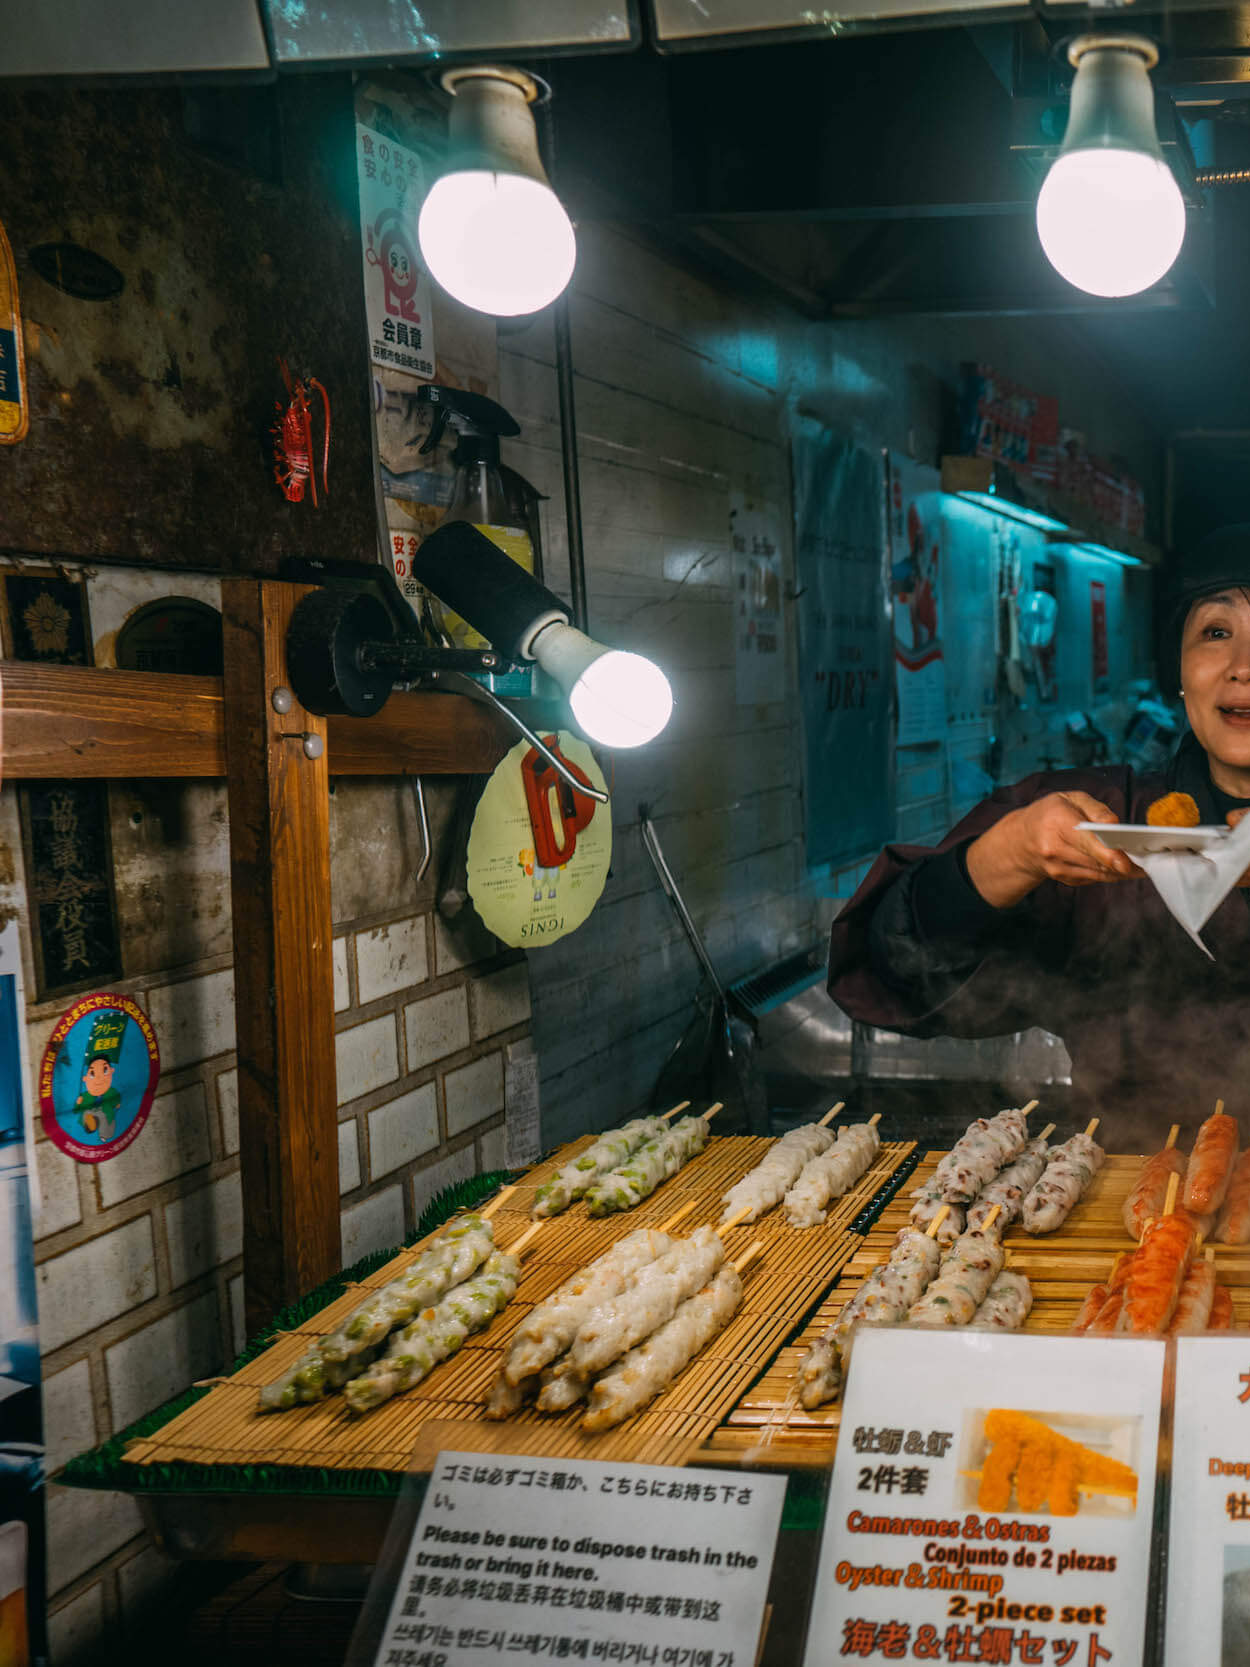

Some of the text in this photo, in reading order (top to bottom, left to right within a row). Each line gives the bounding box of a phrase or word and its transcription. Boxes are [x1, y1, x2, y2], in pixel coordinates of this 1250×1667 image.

[382, 318, 423, 351] 会員章
[393, 535, 419, 556] 安全
[521, 916, 566, 939] IGNIS
[857, 1464, 930, 1496] 2件套
[433, 1493, 458, 1513] い。
[423, 1525, 758, 1570] Please be sure to dispose trash in the
[924, 1542, 1117, 1576] Conjunto de 2 piezas
[416, 1550, 599, 1582] trash or bring it here.
[399, 1596, 427, 1619] 里。
[1059, 1602, 1107, 1626] set
[457, 1627, 505, 1653] 반드시
